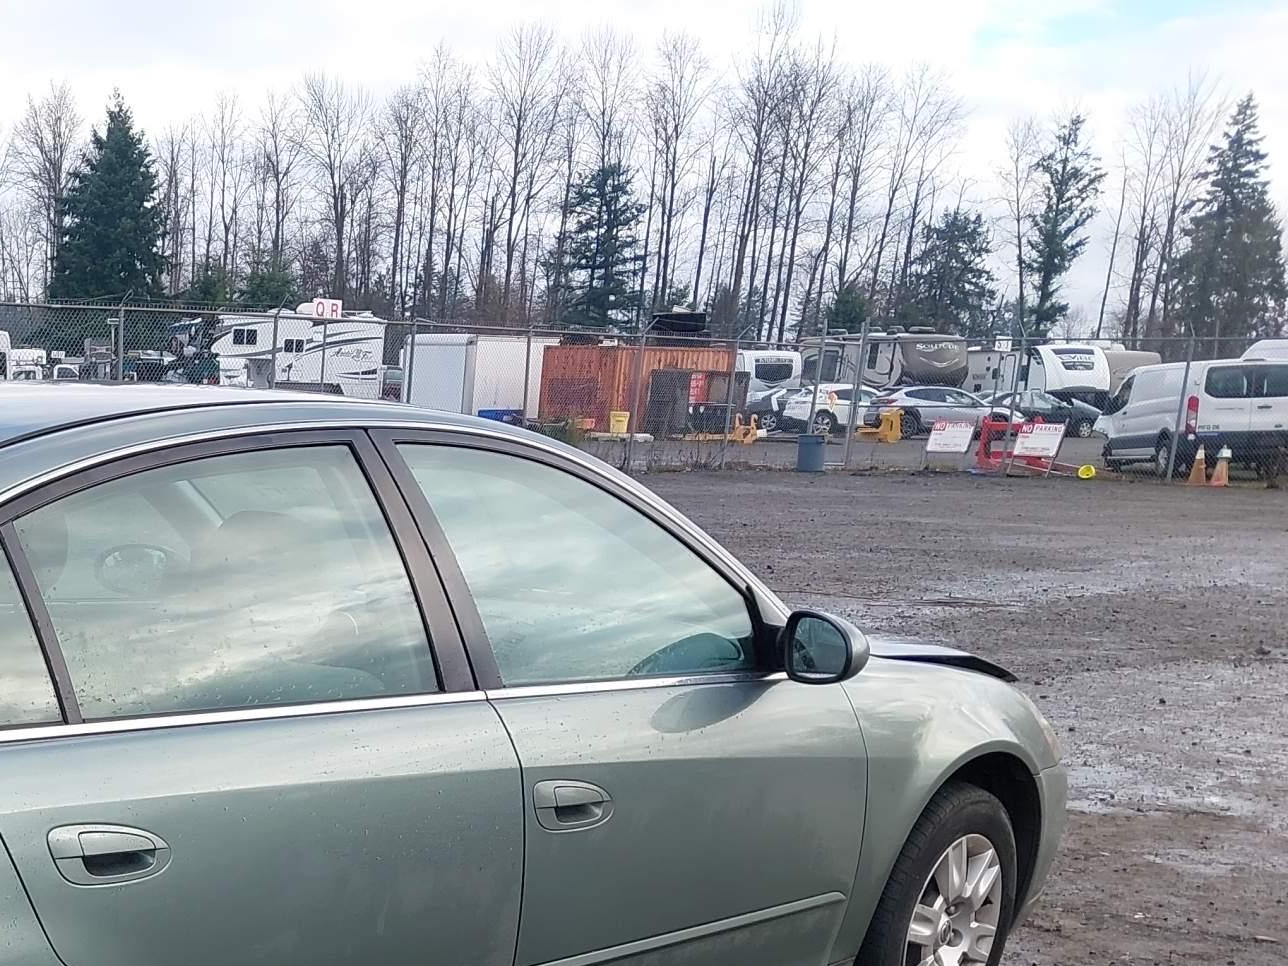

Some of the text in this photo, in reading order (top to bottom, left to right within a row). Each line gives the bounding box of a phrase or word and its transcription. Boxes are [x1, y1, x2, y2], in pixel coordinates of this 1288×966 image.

[316, 301, 339, 318] Q R
[933, 422, 946, 430] NO
[1021, 424, 1063, 433] NO PARKING
